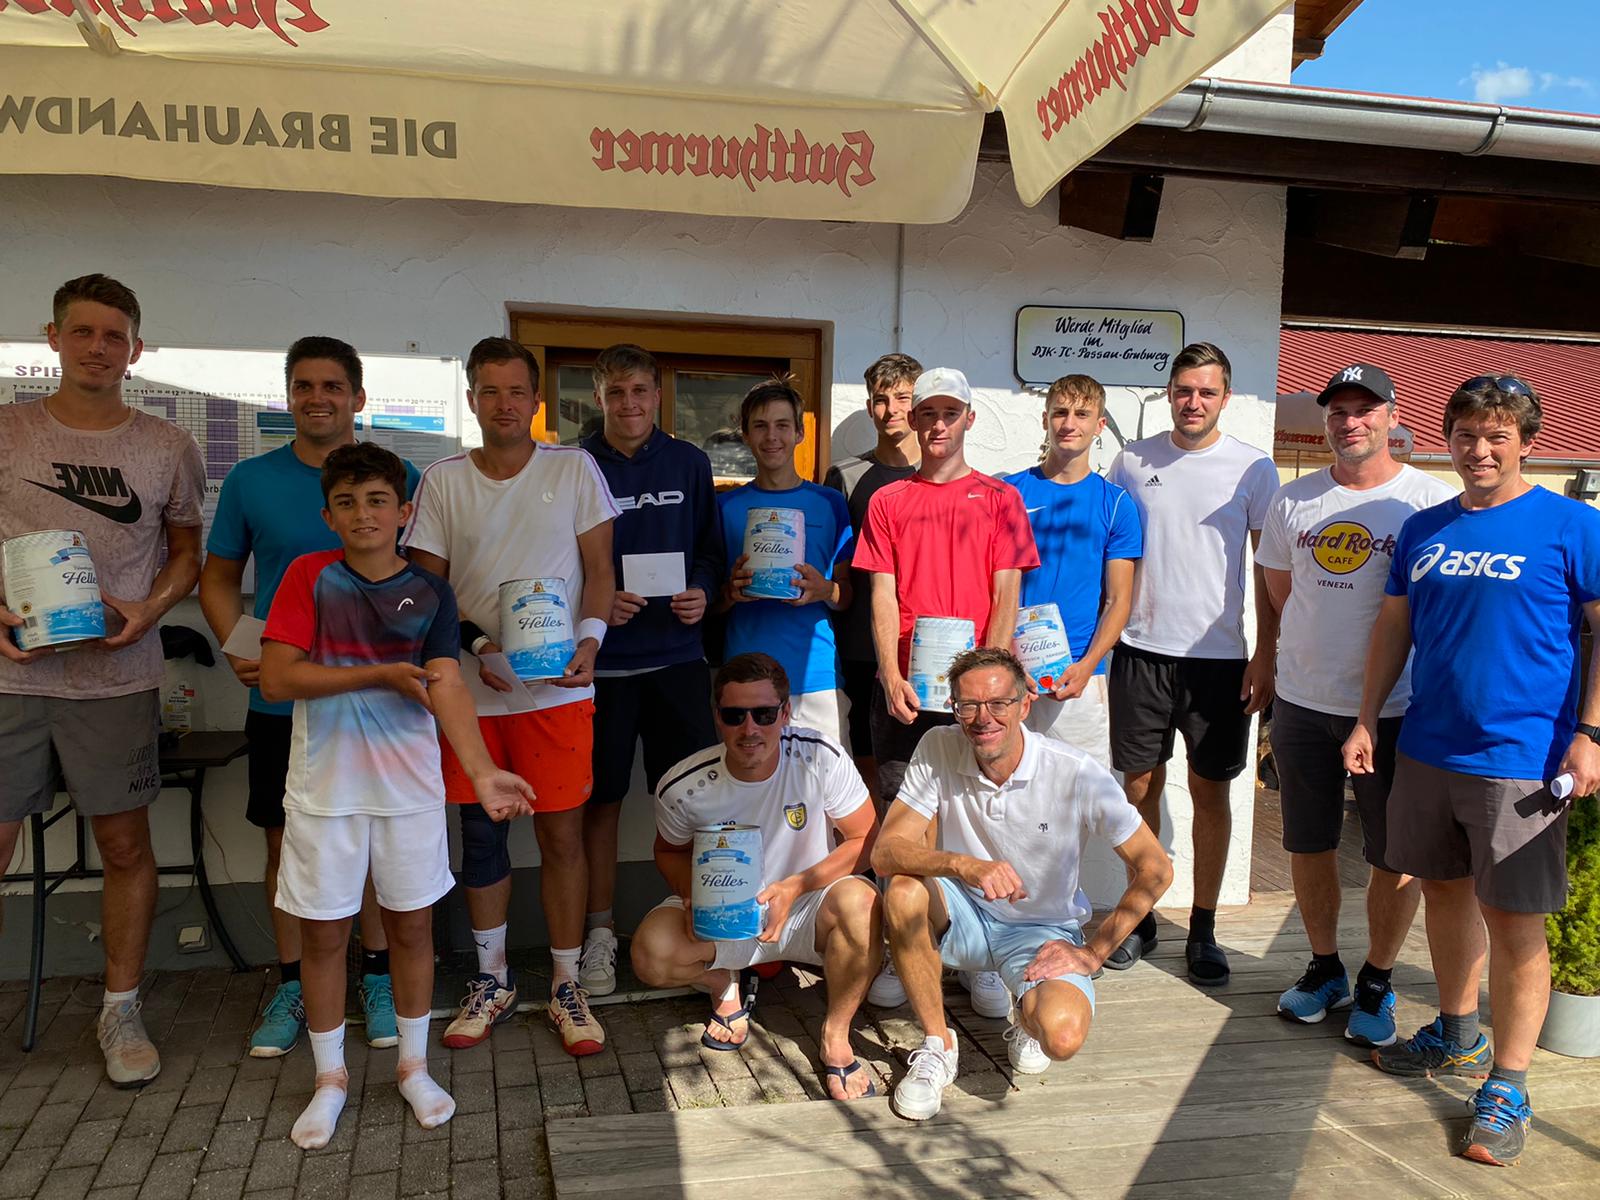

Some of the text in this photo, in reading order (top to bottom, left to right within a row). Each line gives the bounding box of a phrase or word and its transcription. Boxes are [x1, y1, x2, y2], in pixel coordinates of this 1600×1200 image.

[1055, 316, 1154, 341] Werde Mitglied
[204, 485, 223, 494] erb
[753, 541, 793, 554] Helles
[1296, 530, 1397, 557] Hard Rock
[1327, 555, 1354, 565] CAFE
[1316, 579, 1355, 590] VENEZIA
[518, 616, 565, 630] Helles
[1020, 636, 1060, 654] Helles
[128, 771, 157, 794] NIKE
[701, 873, 748, 887] Helles
